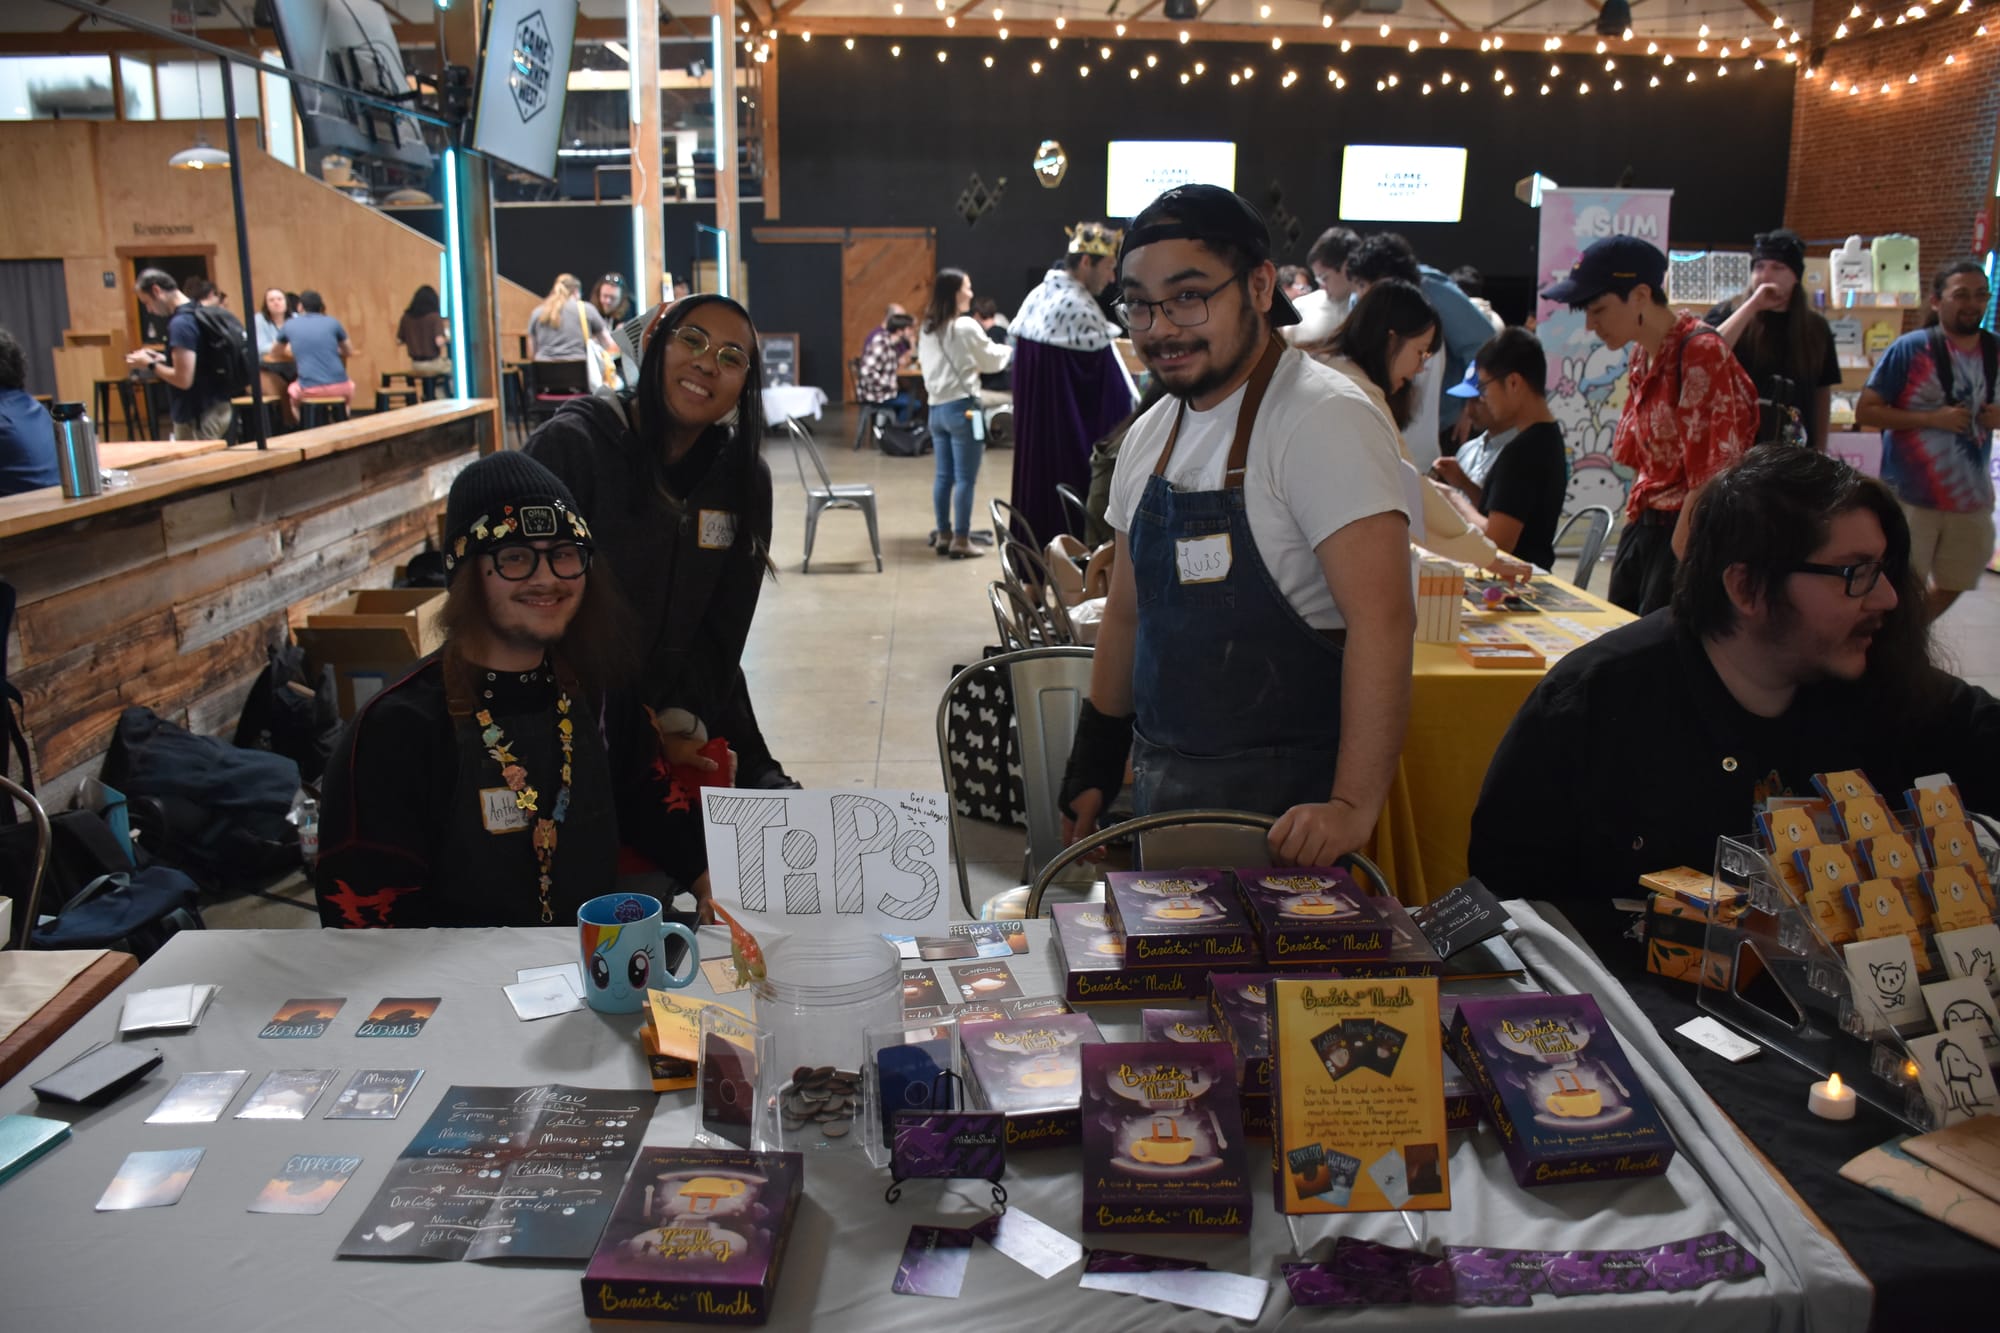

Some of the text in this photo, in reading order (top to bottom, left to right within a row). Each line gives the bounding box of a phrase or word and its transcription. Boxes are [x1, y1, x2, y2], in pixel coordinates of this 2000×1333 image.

[1180, 547, 1221, 577] Luis
[910, 791, 925, 803] Get
[1136, 936, 1246, 959] Barista Month
[1276, 932, 1382, 955] Barista Month
[1077, 973, 1186, 996] Barista Month
[1012, 1000, 1059, 1011] Americano
[1302, 985, 1414, 1009] Barista Month
[951, 1004, 992, 1018] Latte
[261, 1023, 325, 1037] ESPRESSO
[358, 1022, 420, 1036] ESPRESSO
[1501, 1018, 1570, 1043] Barista
[1530, 1034, 1580, 1054] Month
[363, 1072, 406, 1085] Mocha
[1117, 1063, 1193, 1088] Barista
[513, 1087, 588, 1104] Menu
[1142, 1082, 1194, 1101] Month
[545, 1114, 587, 1128] Latte
[1005, 1120, 1067, 1144] Barista
[1532, 1135, 1541, 1146] A
[1544, 1135, 1563, 1145] card
[1566, 1137, 1587, 1145] game
[286, 1155, 361, 1174] ESPRESSO
[1536, 1153, 1661, 1181] Barista Month
[1097, 1177, 1106, 1189] A
[1110, 1179, 1132, 1189] card
[1136, 1182, 1158, 1191] game
[1163, 1180, 1184, 1189] about
[1186, 1180, 1210, 1190] making
[1096, 1205, 1243, 1227] Barista Month
[654, 1240, 734, 1263] Barista
[599, 1283, 756, 1315] Barista Month
